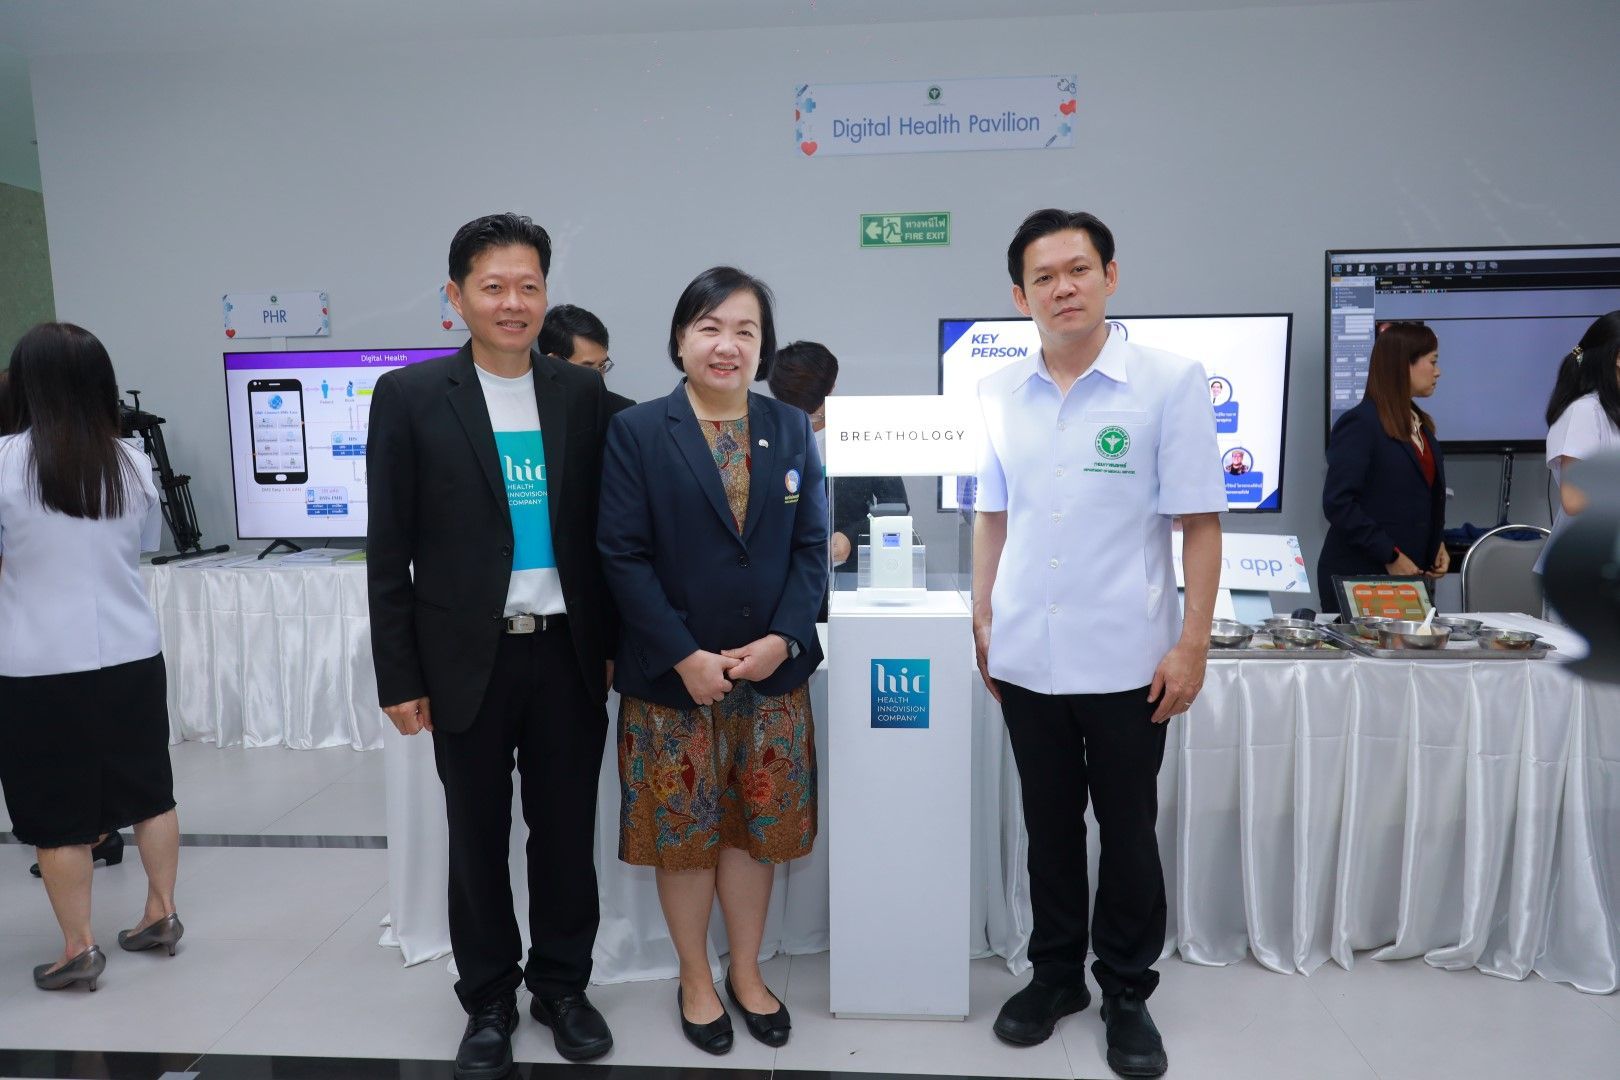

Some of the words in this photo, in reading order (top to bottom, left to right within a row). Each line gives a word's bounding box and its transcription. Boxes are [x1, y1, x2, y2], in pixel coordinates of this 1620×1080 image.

[833, 116, 891, 143] Digital
[900, 114, 960, 136] Health
[969, 111, 1040, 133] Pavilion
[904, 232, 924, 240] FIRE
[926, 231, 946, 240] EXIT
[262, 309, 288, 324] PHR
[971, 333, 999, 344] KEY
[971, 347, 1028, 358] PERSON
[360, 354, 382, 364] Digital
[384, 353, 408, 362] Health
[840, 429, 965, 442] BREATHOLOGY
[1240, 558, 1283, 577] app
[877, 705, 926, 713] INNOVISION
[877, 714, 918, 722] COMPANY
